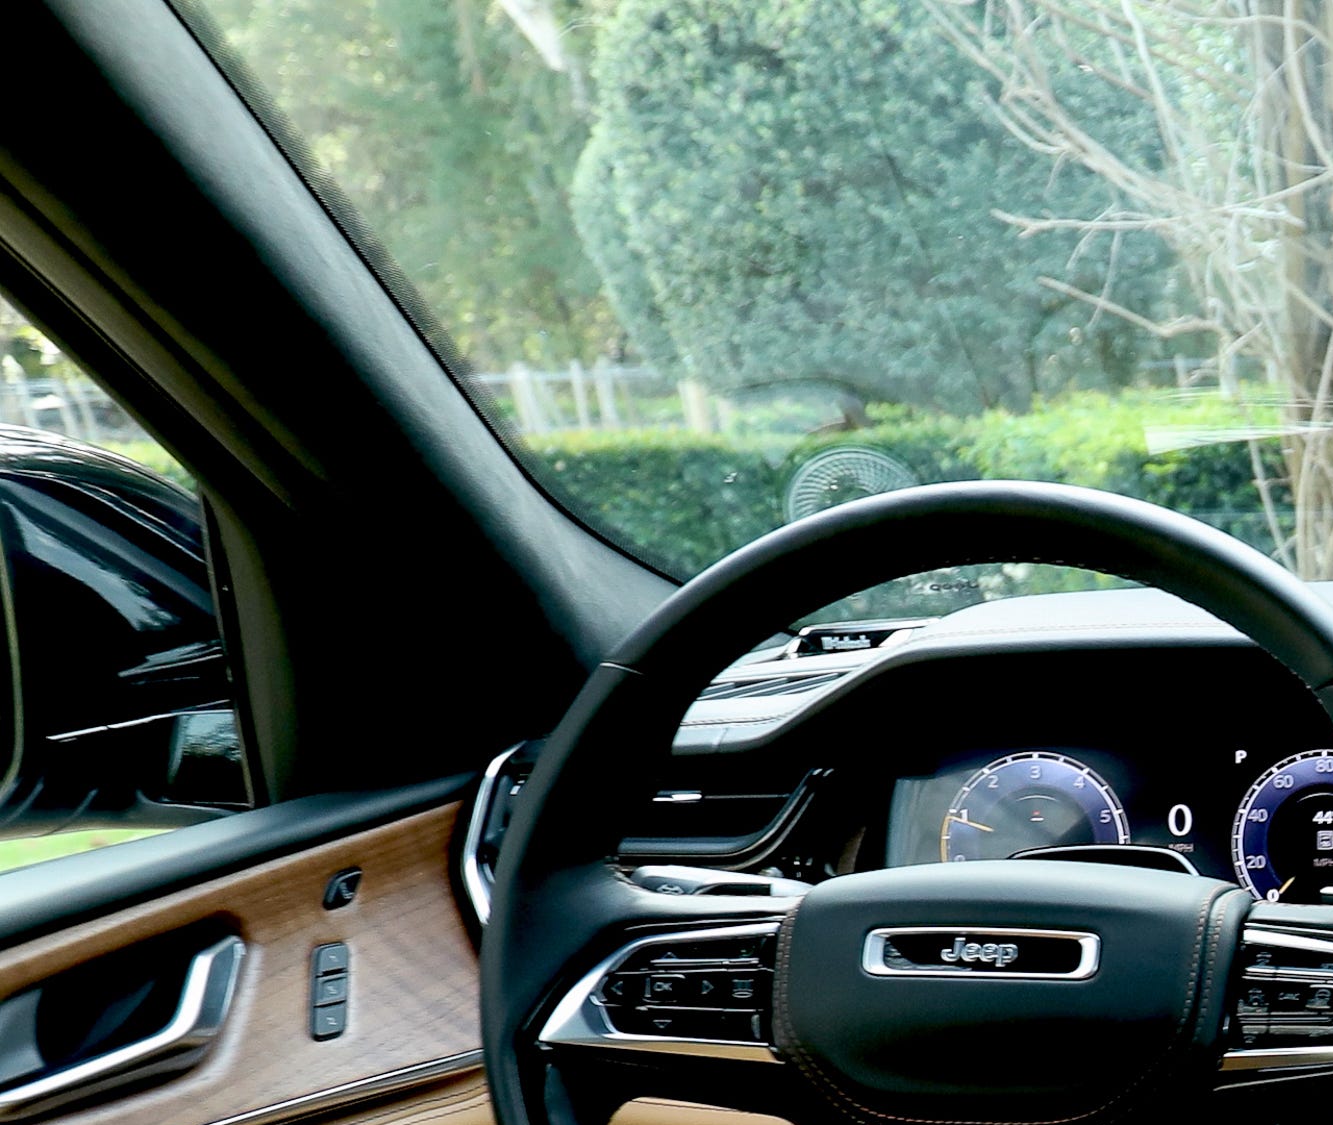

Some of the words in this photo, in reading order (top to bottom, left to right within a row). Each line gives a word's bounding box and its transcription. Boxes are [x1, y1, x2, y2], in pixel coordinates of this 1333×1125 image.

[1235, 750, 1247, 764] P
[1030, 765, 1041, 779] 3
[988, 775, 999, 788] 2
[1073, 776, 1085, 789] 4
[1273, 774, 1294, 788] 60
[959, 809, 968, 822] 1
[1100, 809, 1112, 823] 5
[1168, 804, 1192, 836] 0
[1247, 808, 1268, 822] 40
[1246, 855, 1266, 869] 20
[940, 937, 1018, 967] Jeep
